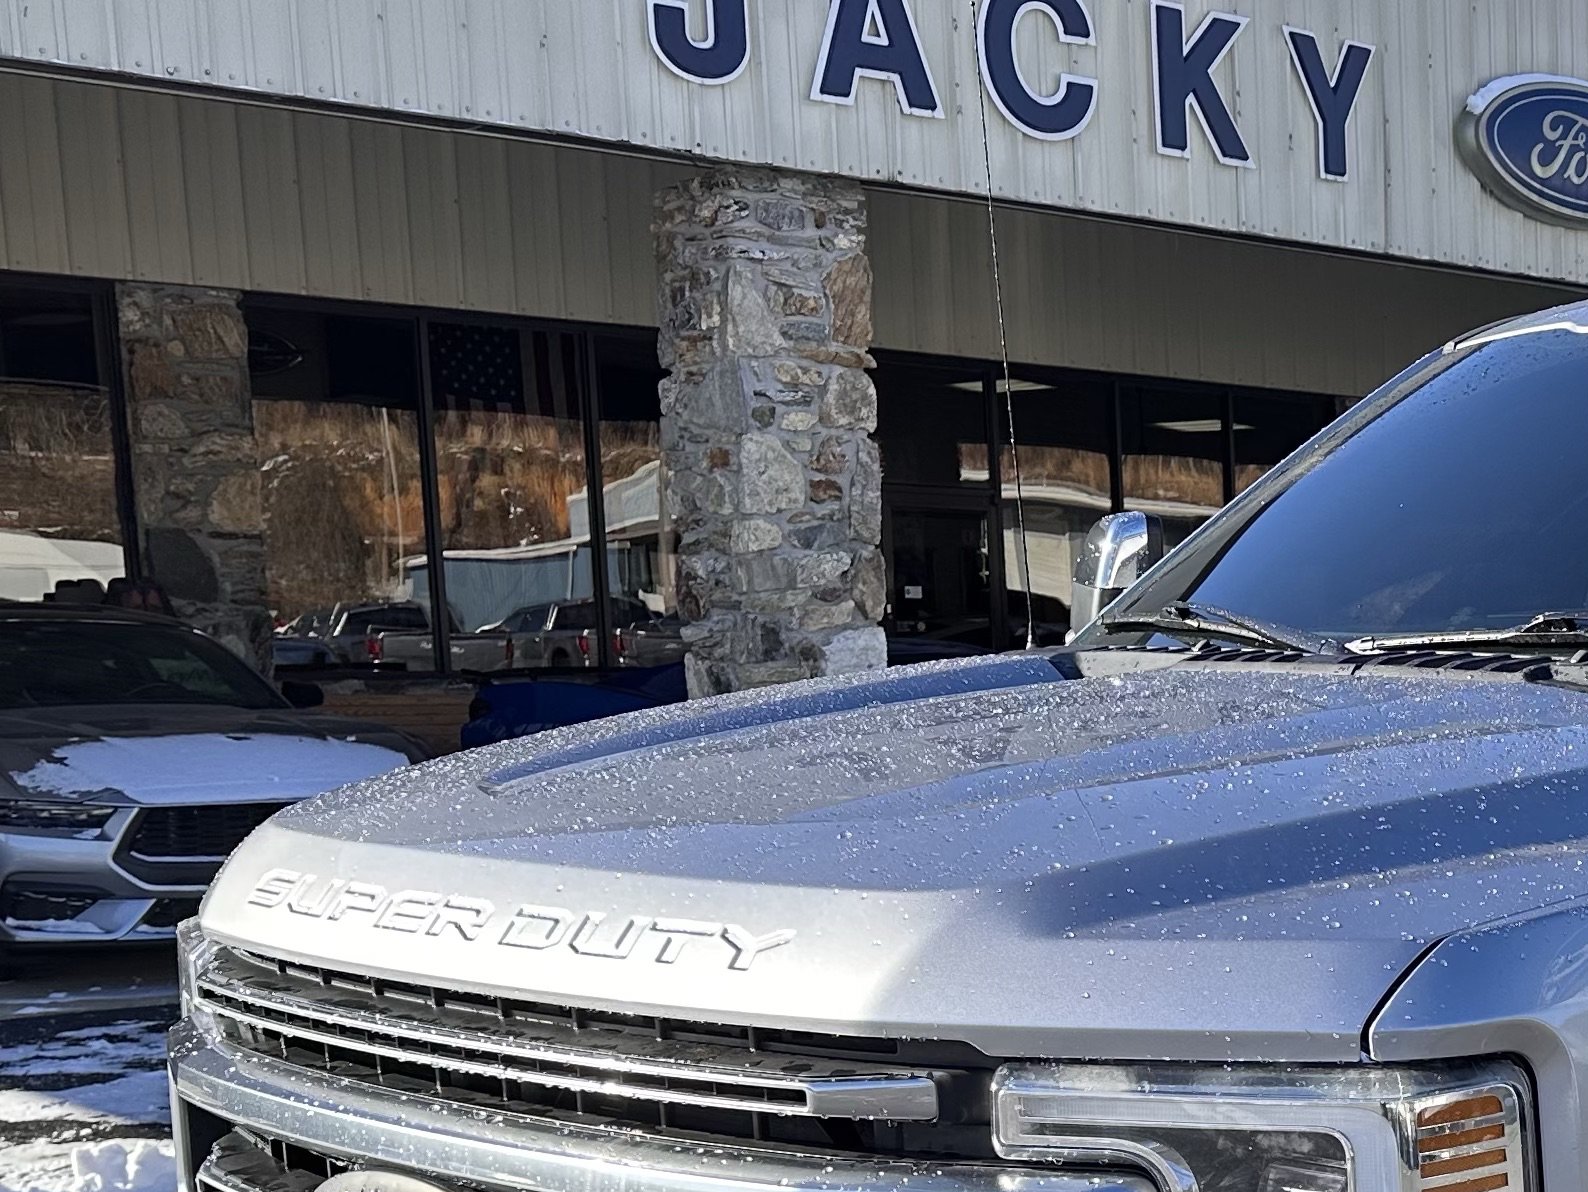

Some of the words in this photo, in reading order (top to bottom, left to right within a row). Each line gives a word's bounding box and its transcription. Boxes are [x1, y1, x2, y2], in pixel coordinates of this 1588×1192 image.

[648, 0, 1377, 183] JACKY
[248, 867, 496, 941] SUPER
[498, 903, 797, 971] DUTY
